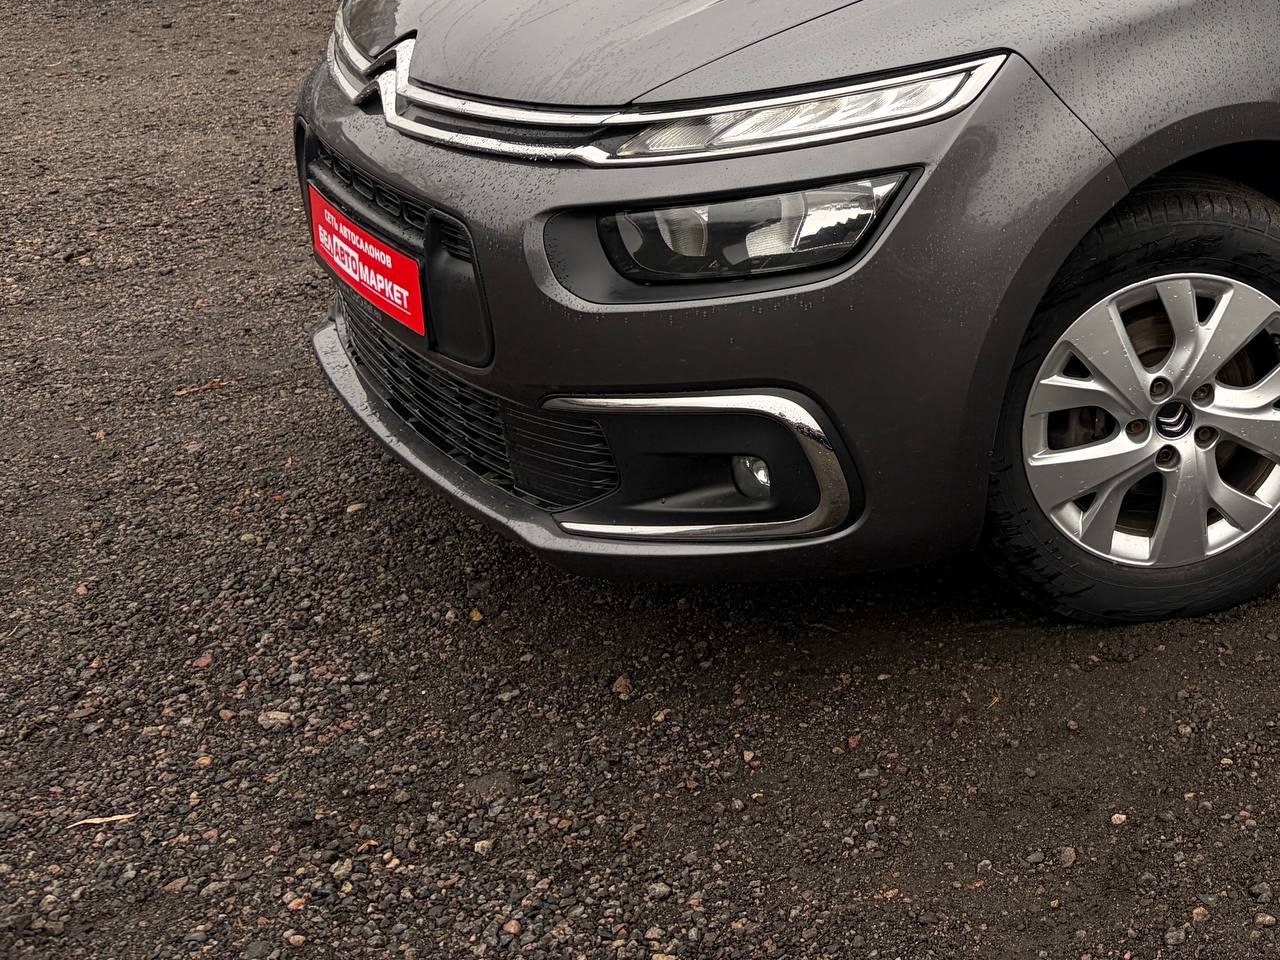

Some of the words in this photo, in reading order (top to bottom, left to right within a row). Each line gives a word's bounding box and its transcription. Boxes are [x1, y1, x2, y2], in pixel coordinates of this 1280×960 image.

[324, 209, 339, 231] СЕТЬ
[339, 223, 392, 268] АВТОСАЛОНОВ
[360, 262, 409, 309] МАРКЕТ
